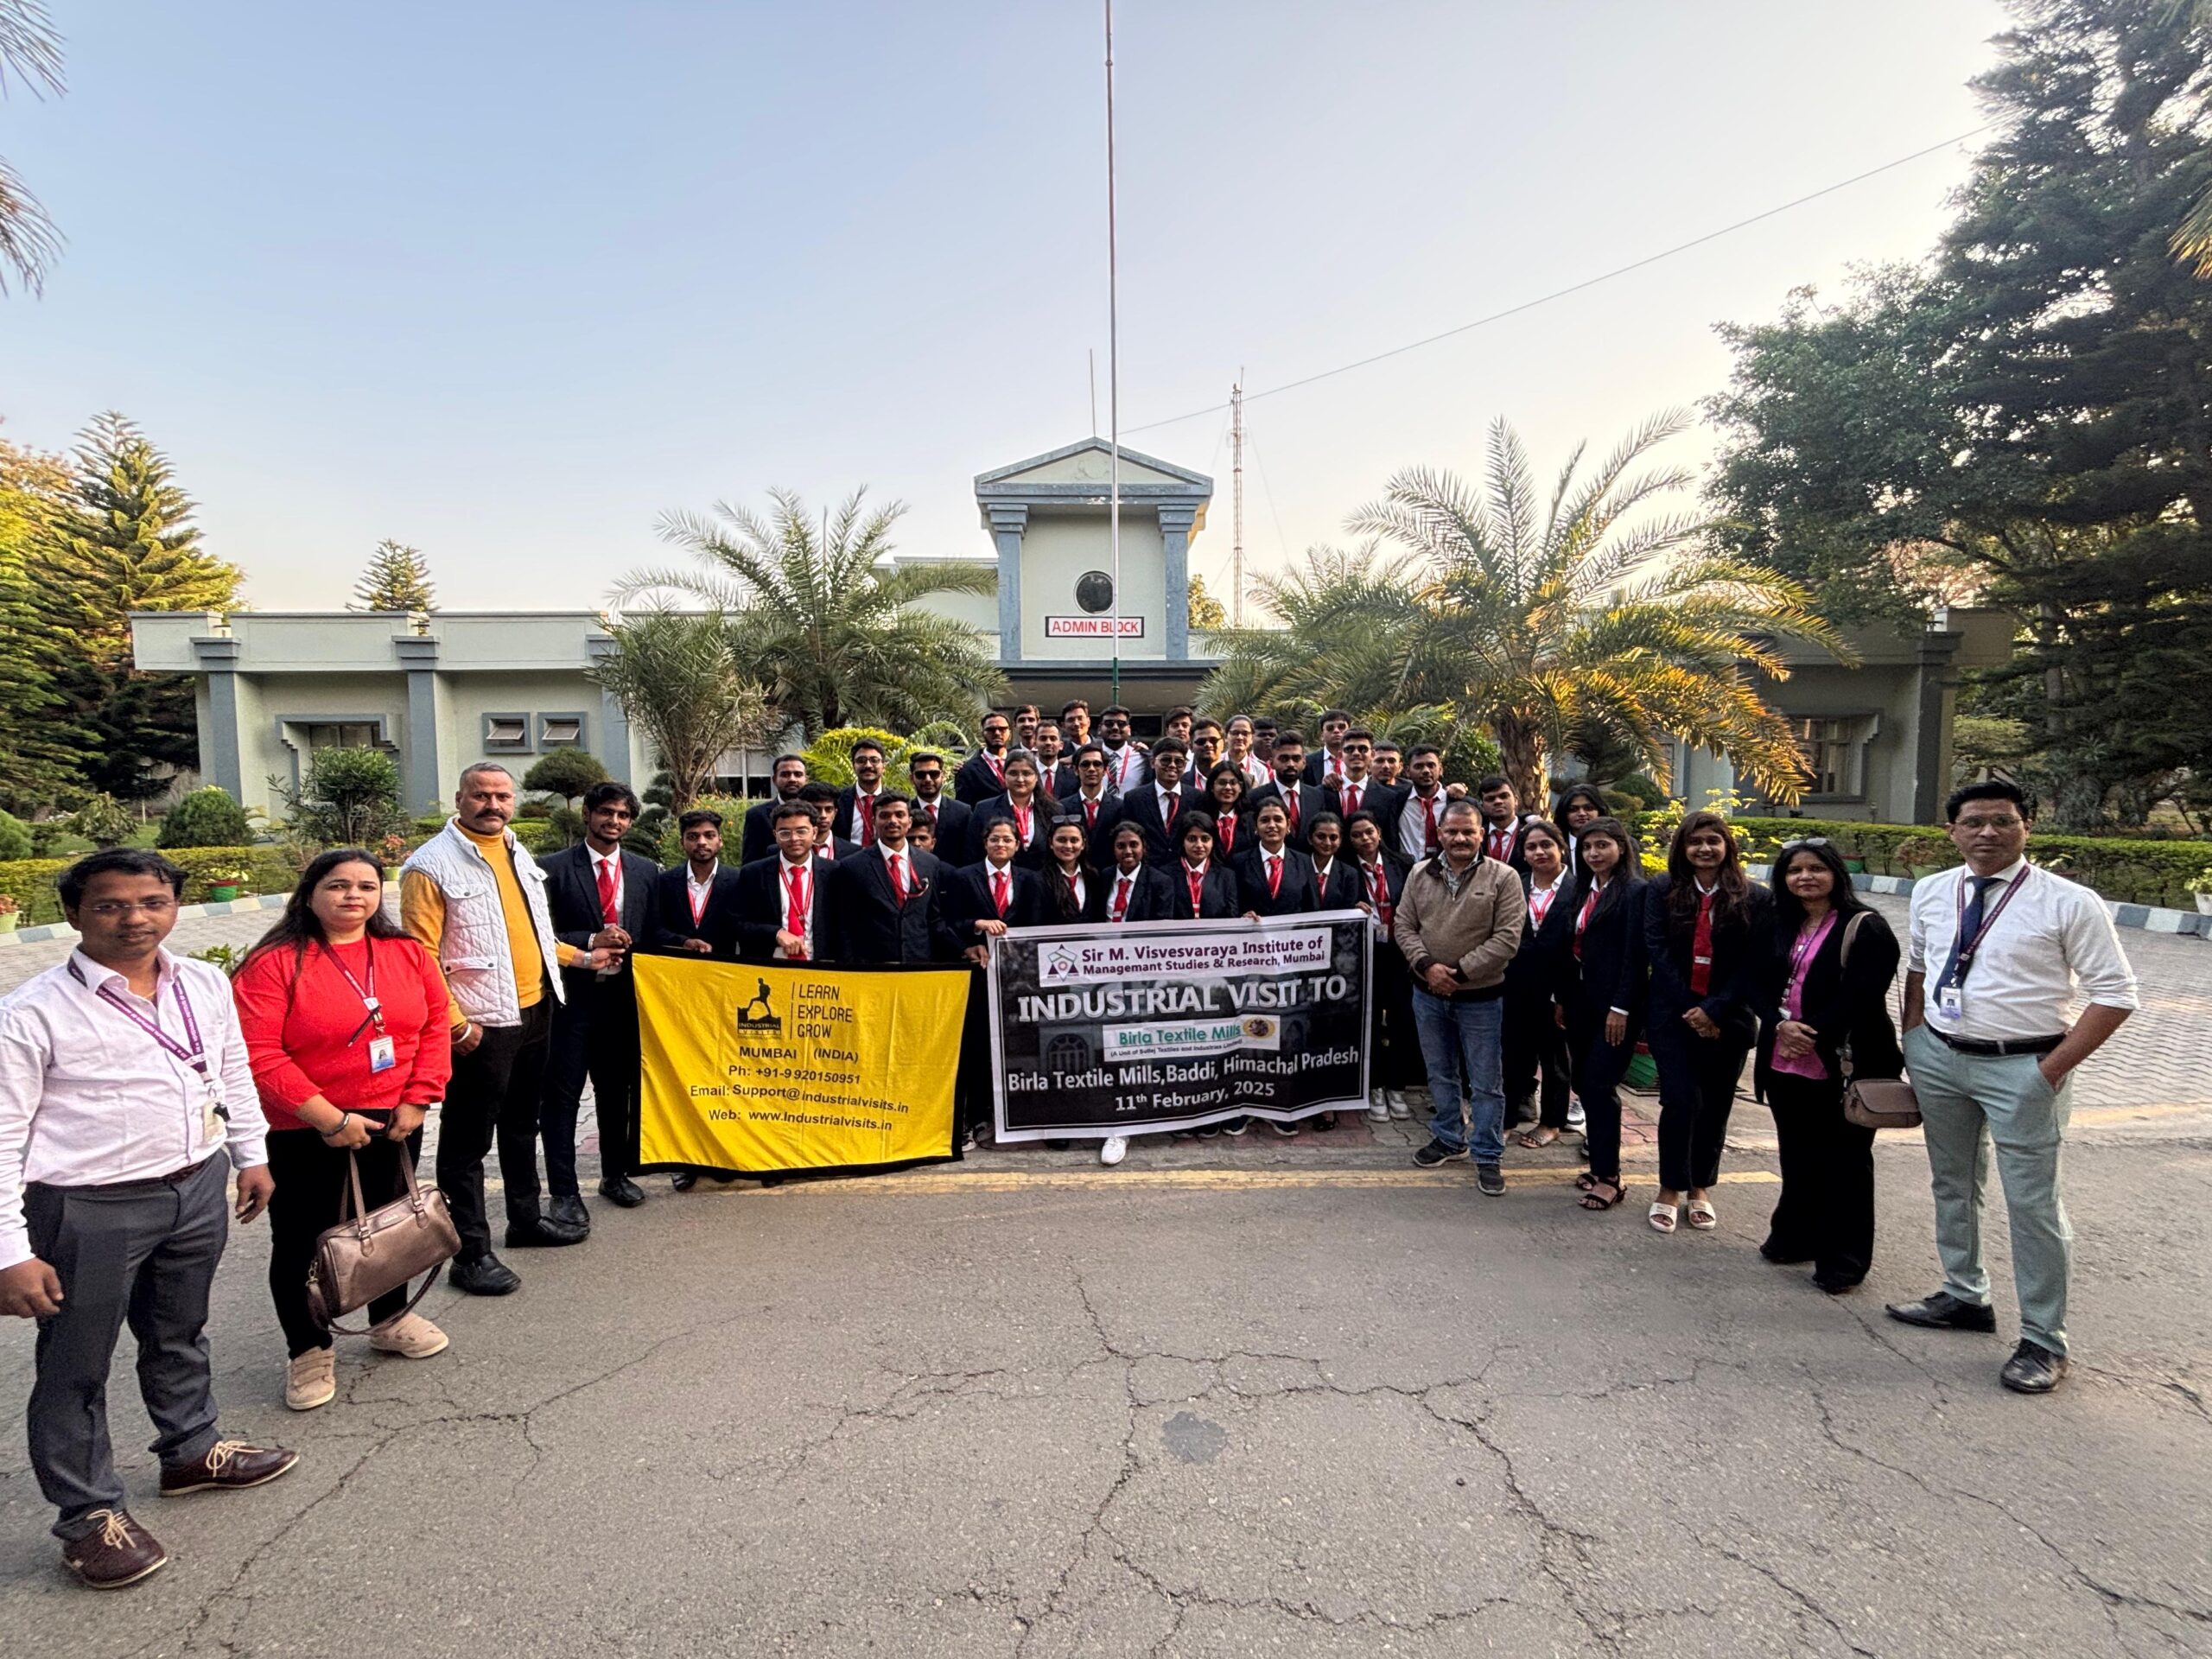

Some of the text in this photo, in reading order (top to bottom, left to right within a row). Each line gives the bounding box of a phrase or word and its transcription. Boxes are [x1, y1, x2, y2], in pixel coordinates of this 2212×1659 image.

[1052, 620, 1097, 633] ADMIN
[1082, 935, 1323, 962] Sir M. Visvesvaraya Institute of
[1084, 950, 1325, 975] Managemant Studies & Research, Mumbai
[798, 983, 840, 1001] LEARN
[1018, 974, 1347, 1022] INDUSTRIAL VISIT TO
[798, 1004, 853, 1023] EXPLORE
[798, 1024, 832, 1039] GROW
[1119, 1024, 1241, 1046] Birla Textile Mills
[739, 1046, 859, 1064] MUMBAI (INDIA)
[728, 1065, 751, 1077] Ph:
[1007, 1071, 1048, 1091] Birla
[1052, 1068, 1114, 1090] Textile
[1224, 1054, 1297, 1075] Himachal
[1301, 1046, 1358, 1071] Pradesh
[690, 1085, 729, 1097] Email:
[1153, 1087, 1229, 1109] February,
[1234, 1080, 1274, 1096] 2025
[709, 1109, 741, 1121] Web:
